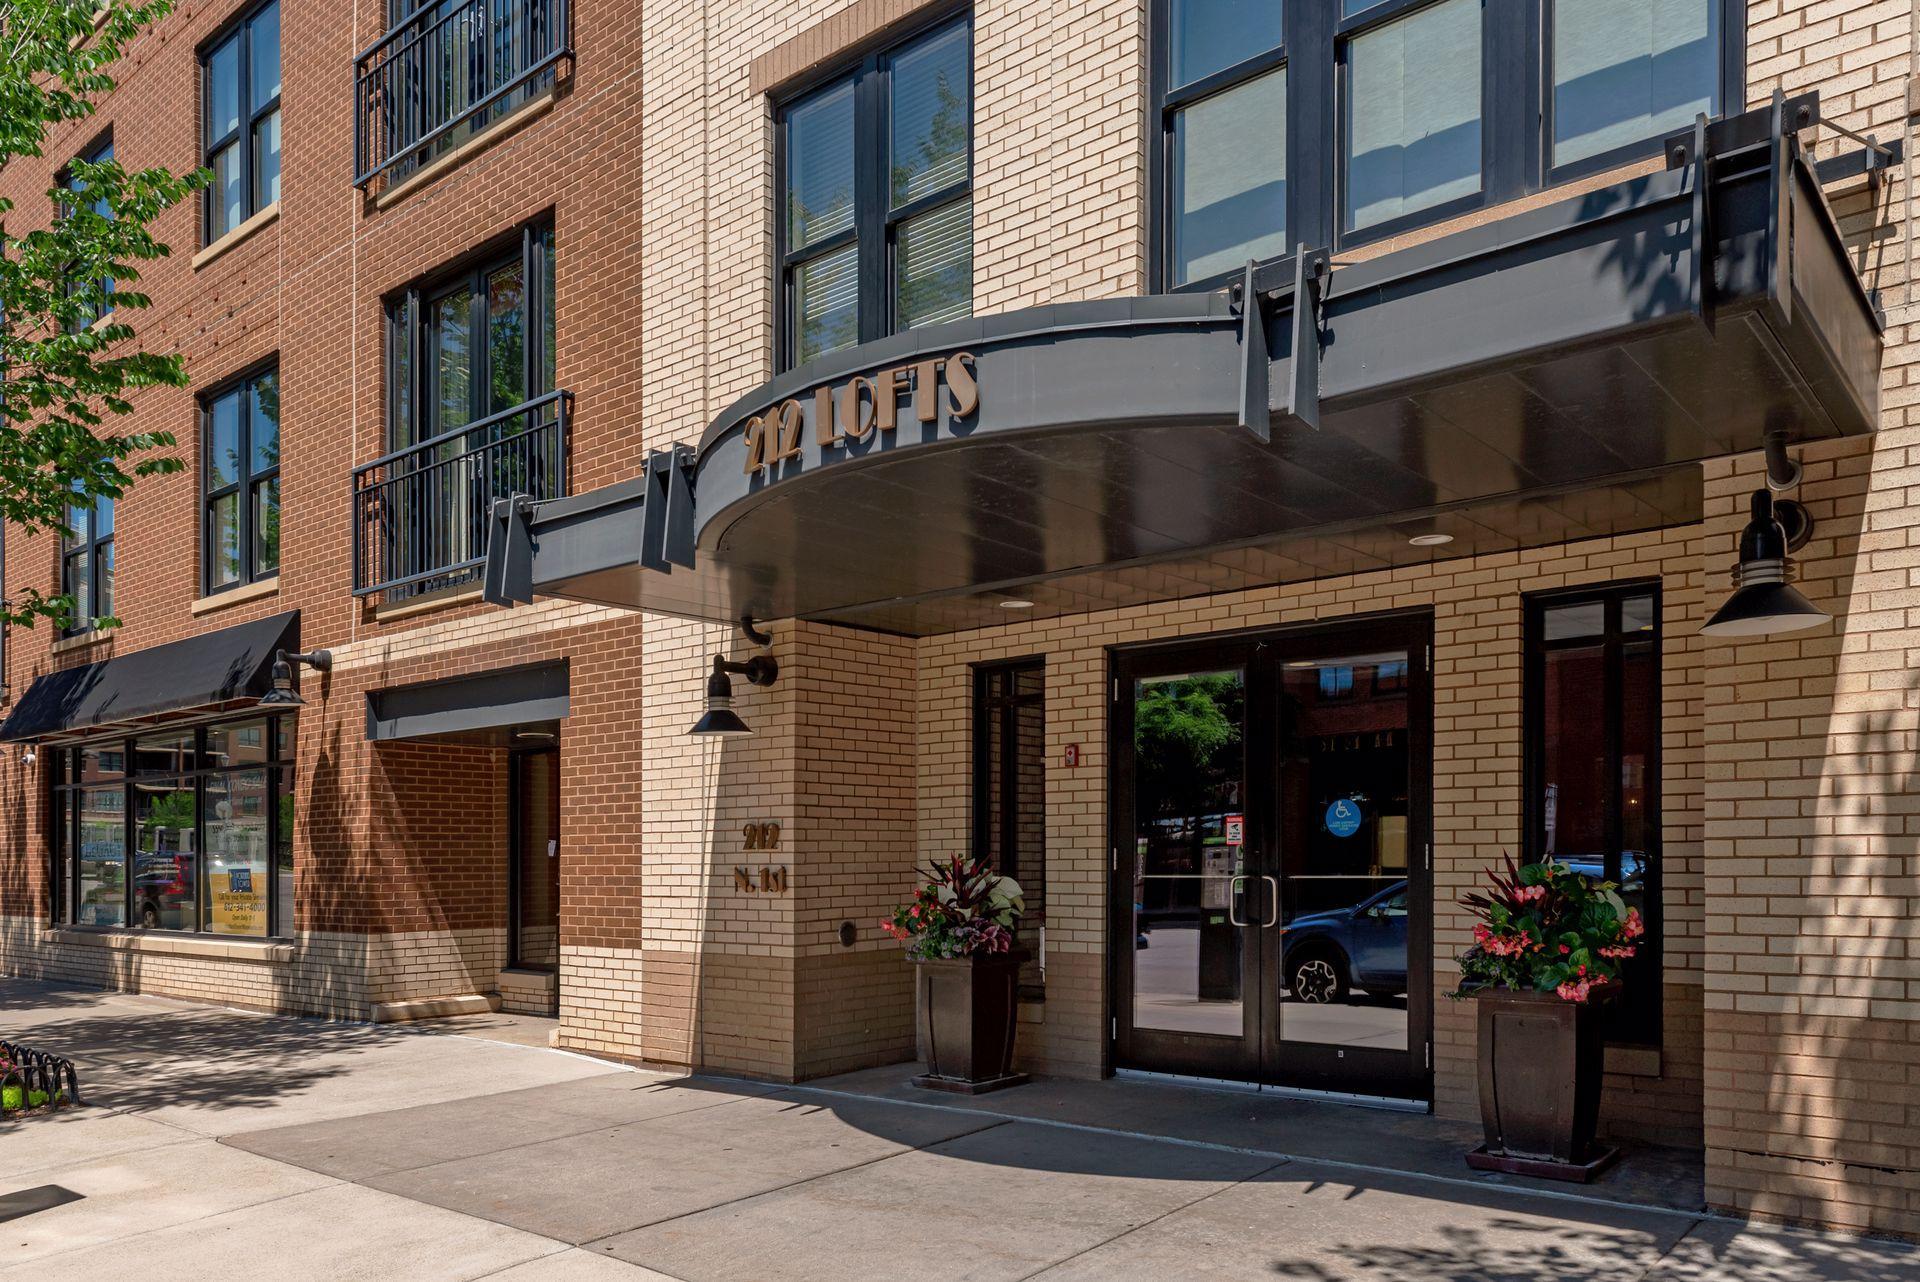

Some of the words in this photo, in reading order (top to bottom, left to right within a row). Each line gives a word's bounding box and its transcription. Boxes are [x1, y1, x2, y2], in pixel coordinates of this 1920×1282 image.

[744, 398, 803, 475] 212
[815, 352, 979, 446] LOFTS
[742, 823, 780, 850] 212
